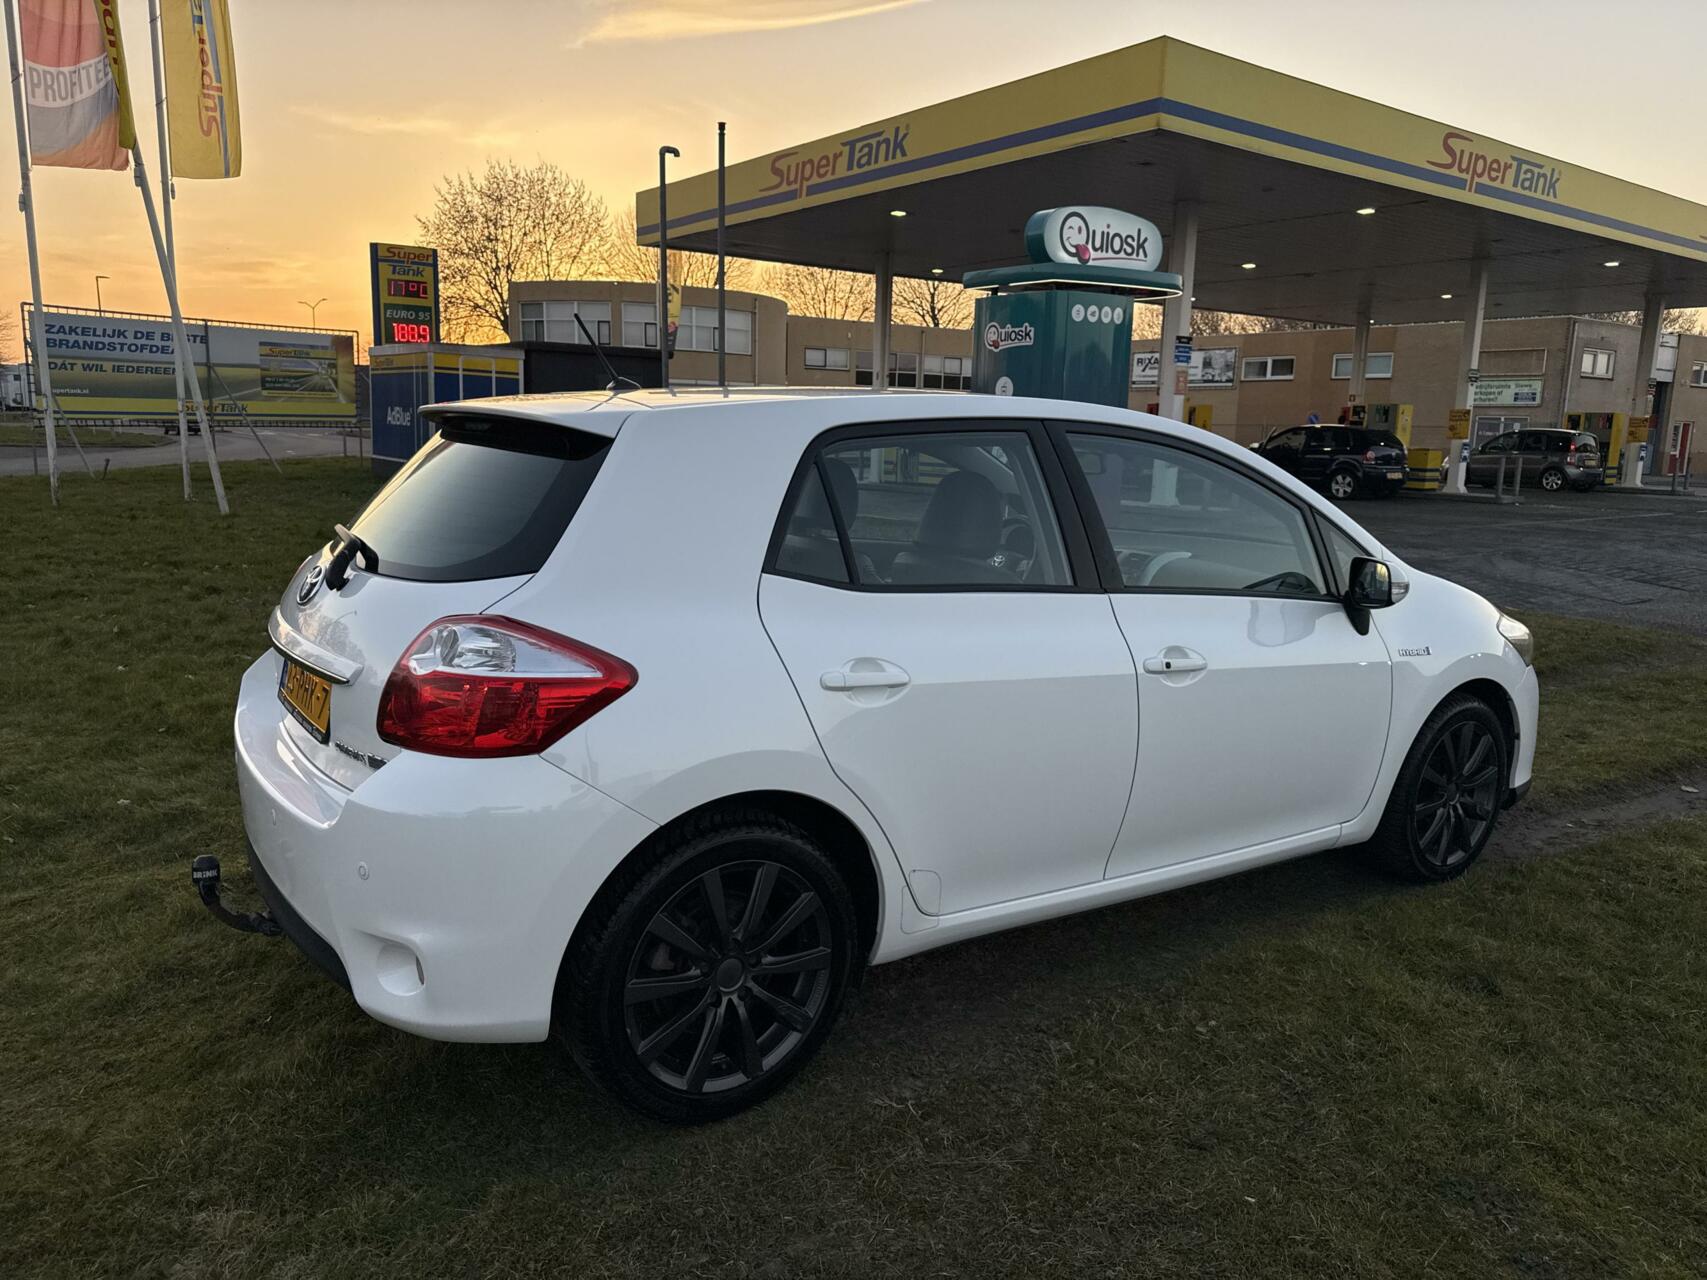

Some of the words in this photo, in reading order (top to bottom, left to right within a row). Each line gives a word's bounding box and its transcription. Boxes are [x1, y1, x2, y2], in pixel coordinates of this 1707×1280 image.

[759, 126, 909, 199] SuperTank
[1426, 132, 1561, 199] SuperTank
[1060, 211, 1149, 264] Quiosk
[380, 247, 432, 267] Super
[387, 264, 425, 277] Tank
[386, 310, 415, 319] EURO
[418, 312, 430, 320] 95
[45, 324, 128, 339] ZAKELIJK
[133, 331, 156, 341] DE
[986, 324, 1032, 350] Quiosk
[46, 338, 175, 355] BRANDSTOFDE
[81, 363, 108, 373] WIL
[386, 406, 411, 426] AdBlue
